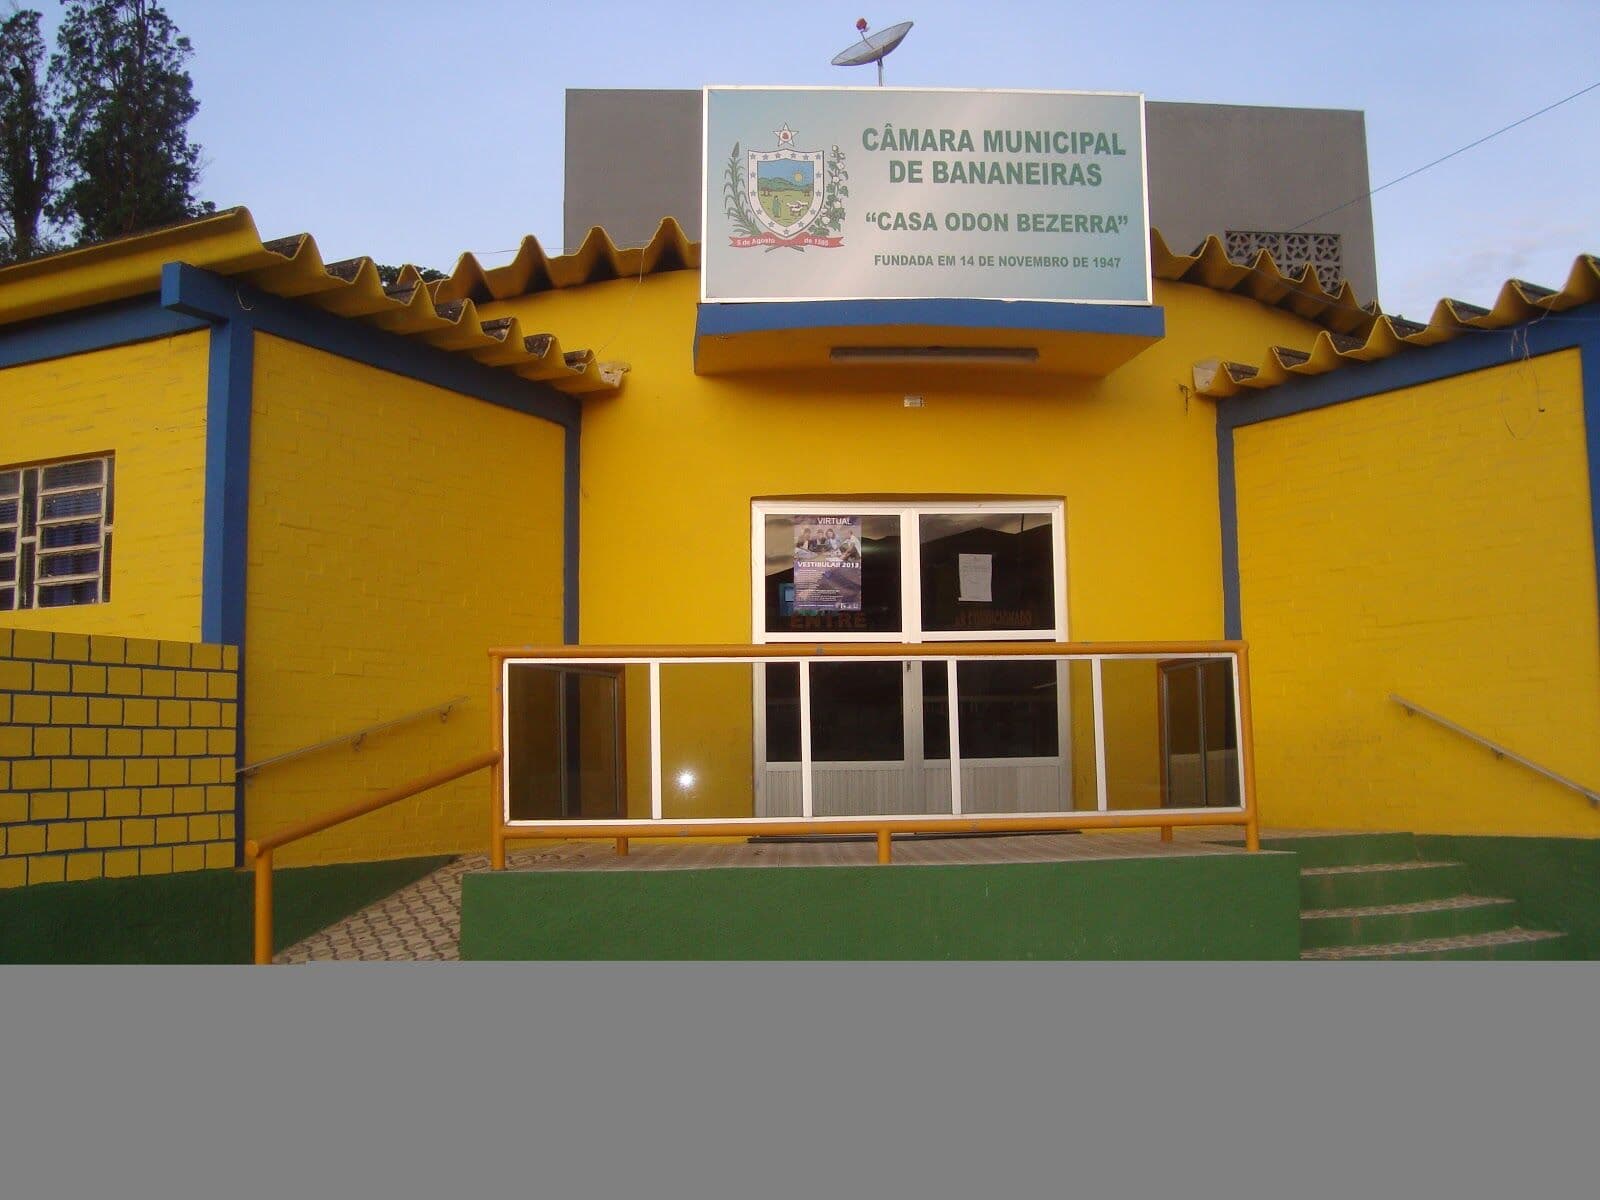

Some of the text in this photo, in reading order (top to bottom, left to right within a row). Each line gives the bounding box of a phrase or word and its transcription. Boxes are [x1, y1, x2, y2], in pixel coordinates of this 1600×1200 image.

[862, 122, 1127, 156] CÂMARA MUNICIPAL
[889, 159, 1103, 187] DE BANANEIRAS
[944, 212, 1009, 233] ODON
[752, 237, 776, 246] Agosto
[874, 254, 1122, 269] FUNDADA EM 14 DE NOVEMBRO DE 1947
[817, 517, 851, 525] VIRTUAL
